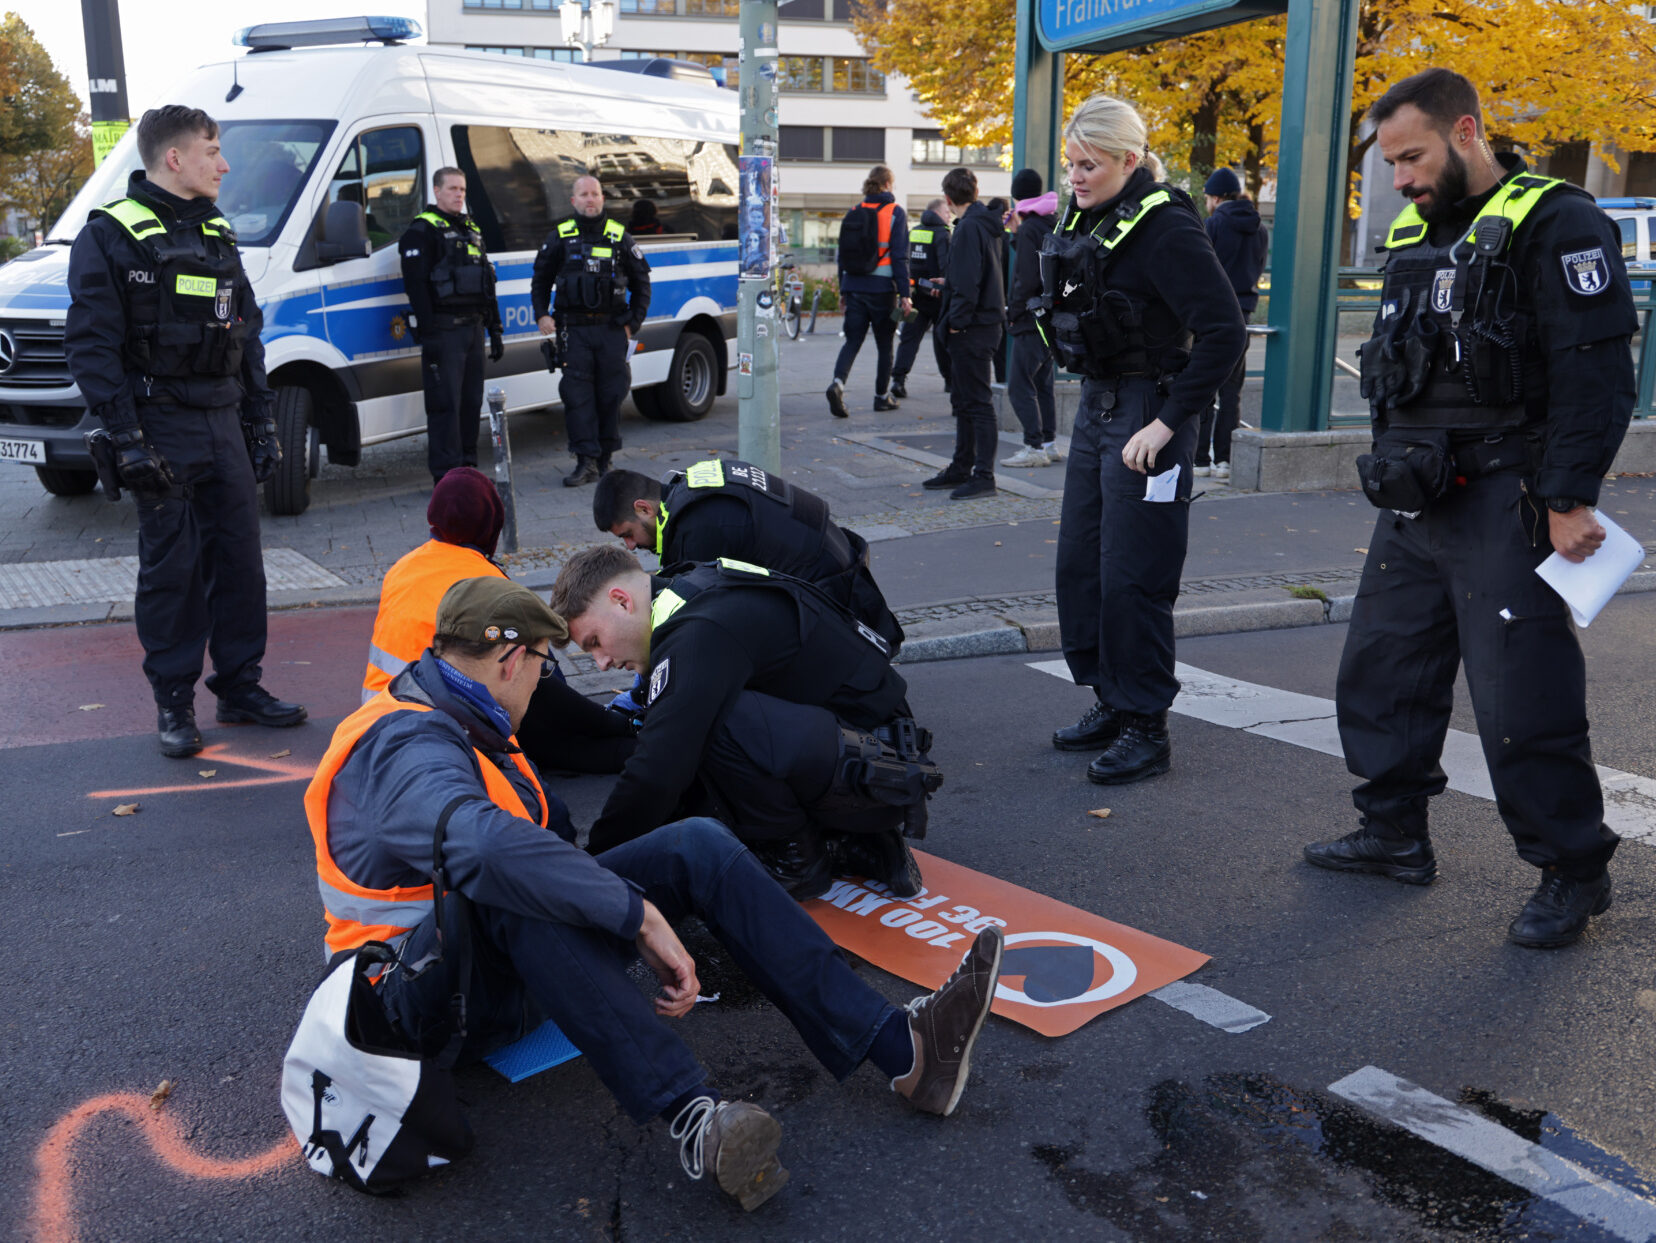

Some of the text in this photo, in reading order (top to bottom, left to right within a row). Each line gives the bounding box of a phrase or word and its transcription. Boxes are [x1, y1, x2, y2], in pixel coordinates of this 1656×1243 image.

[1055, 0, 1154, 29] Frank
[1565, 250, 1601, 264] POLIZEI
[178, 278, 214, 294] POLIZEI
[0, 441, 38, 459] 31774
[731, 466, 748, 478] BE
[879, 908, 966, 948] 100
